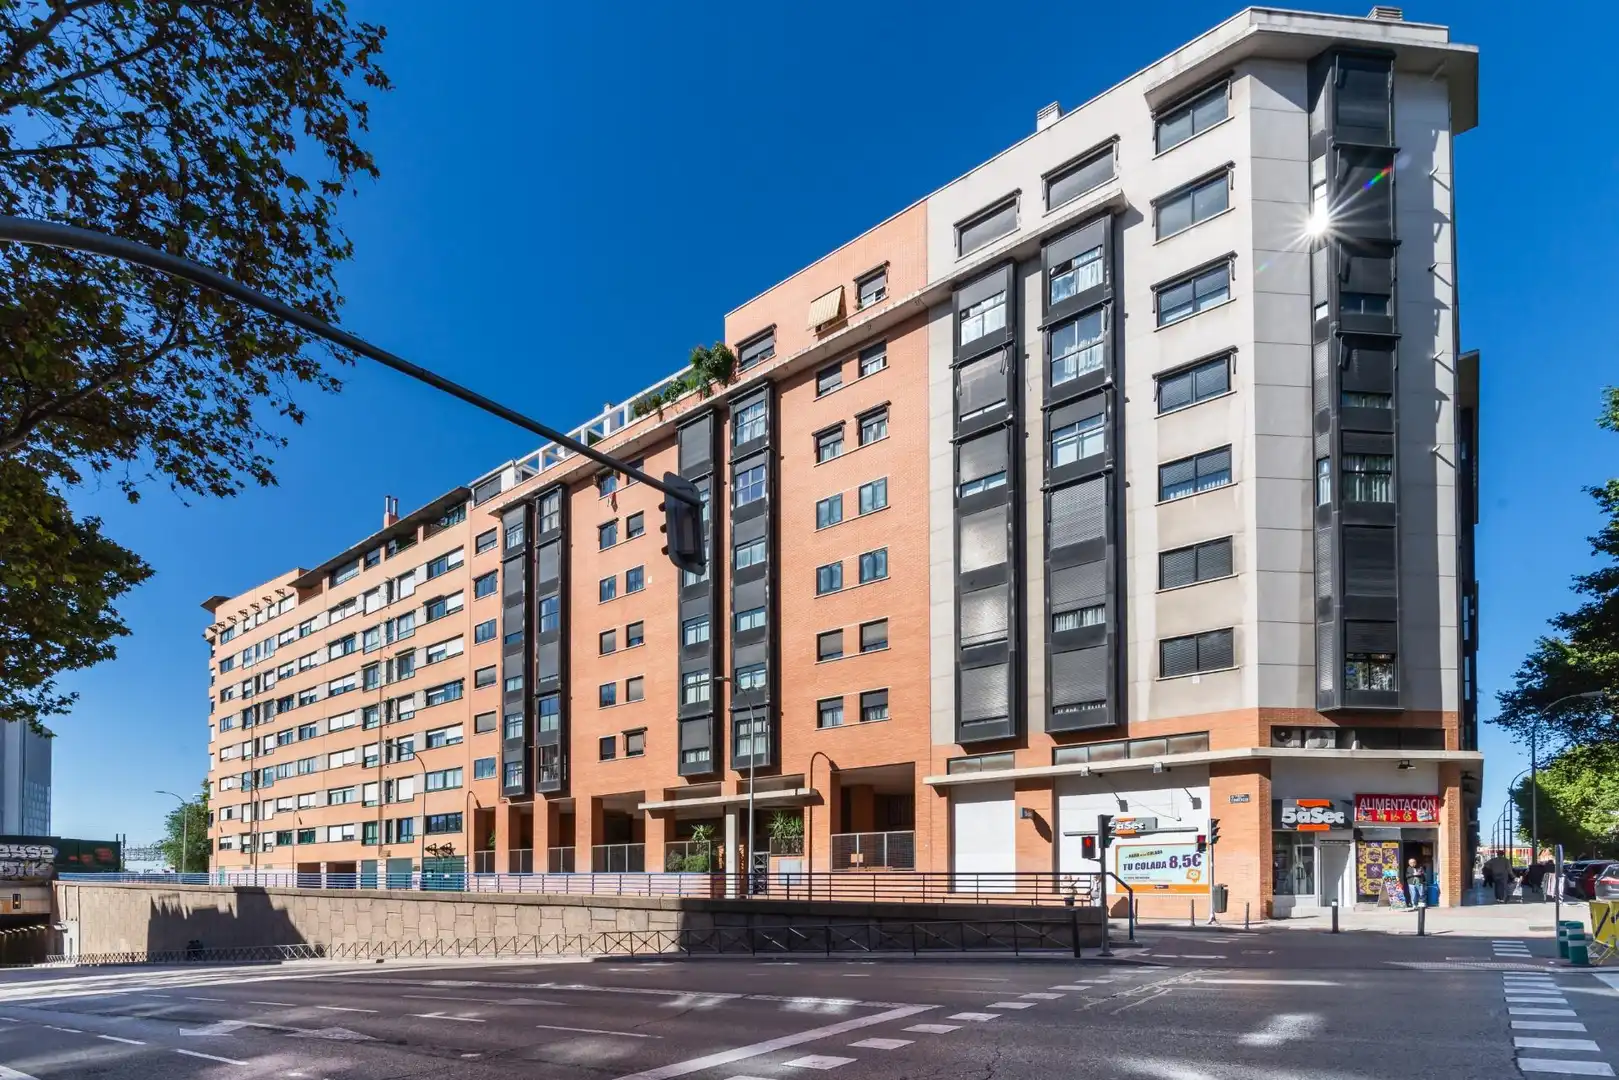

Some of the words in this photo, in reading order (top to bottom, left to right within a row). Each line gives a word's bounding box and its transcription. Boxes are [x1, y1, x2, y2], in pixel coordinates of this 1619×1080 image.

[1359, 796, 1437, 811] ALIMENTACIÓN
[1123, 862, 1133, 871] TU
[1135, 861, 1167, 871] COLADA
[1169, 853, 1202, 870] 8,5€
